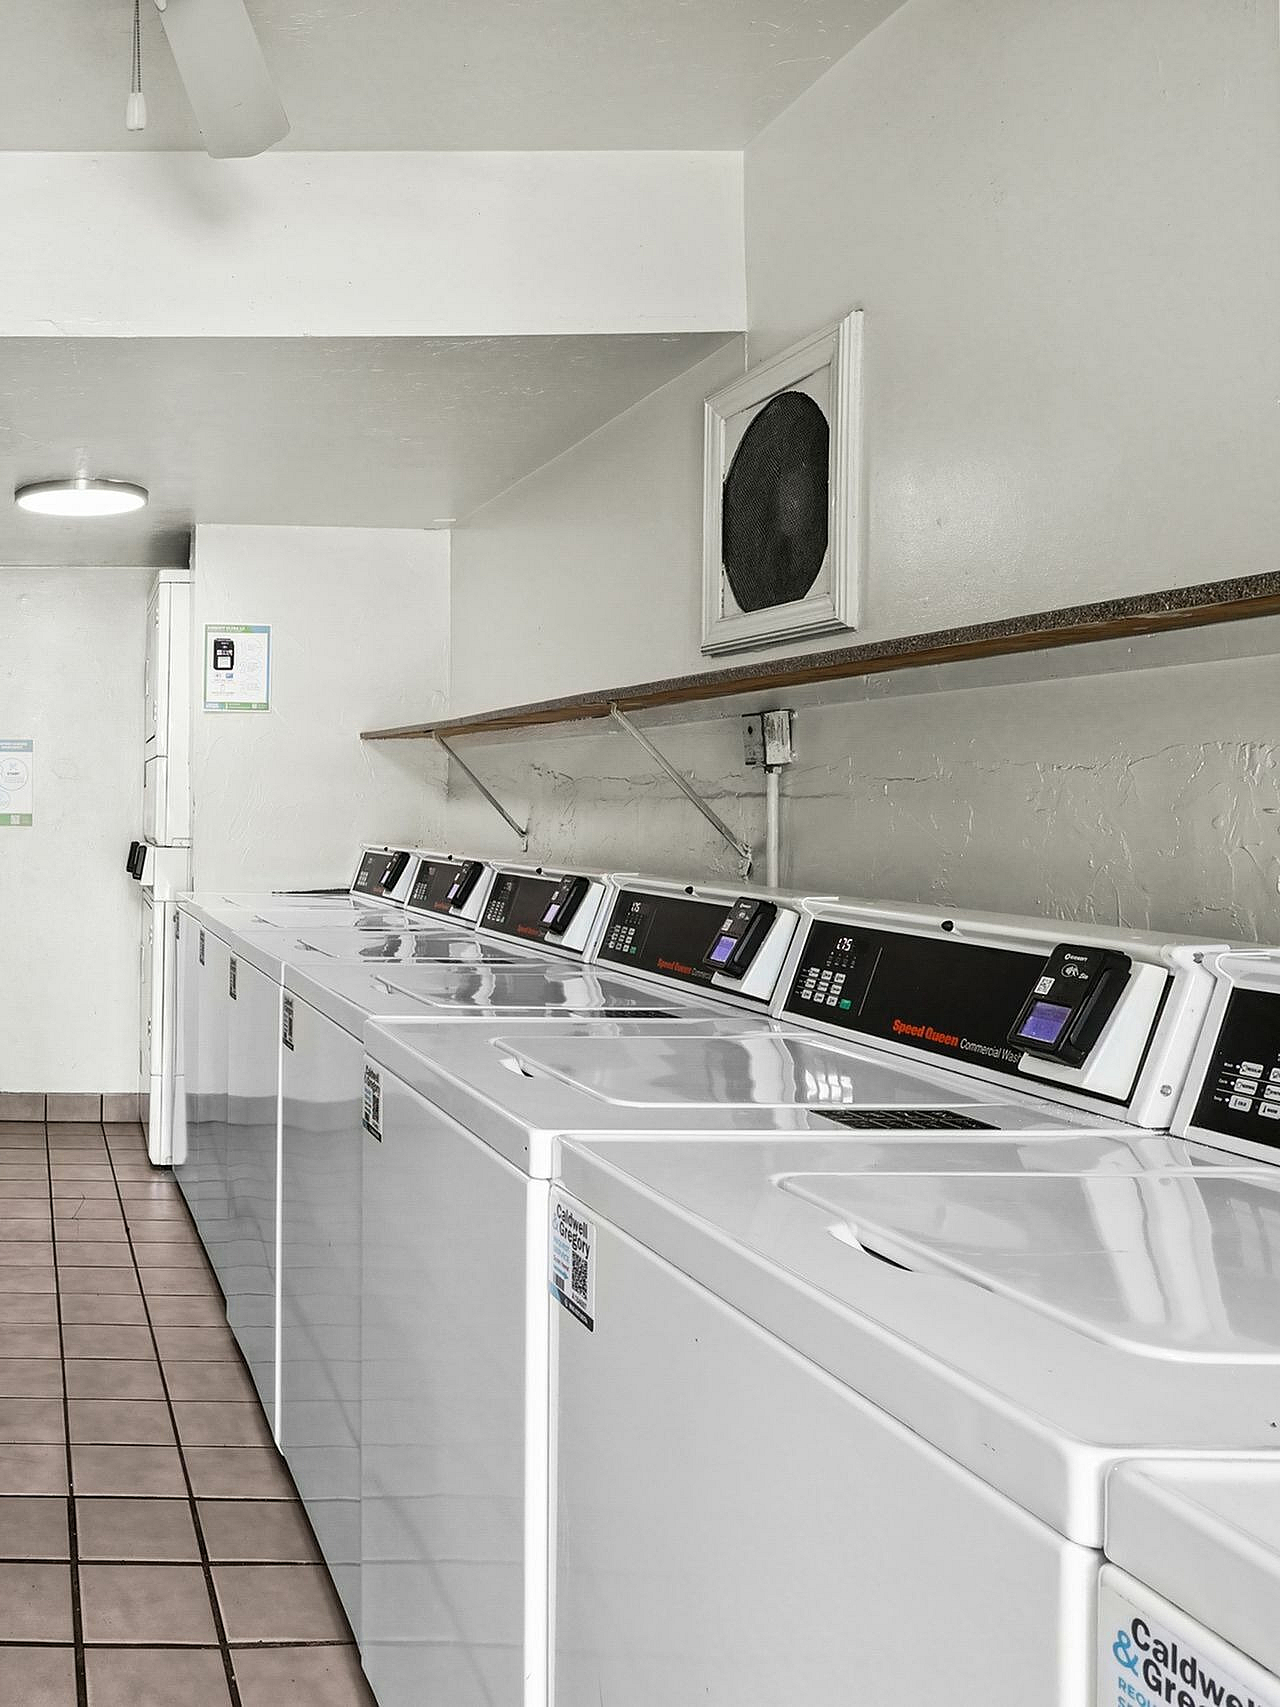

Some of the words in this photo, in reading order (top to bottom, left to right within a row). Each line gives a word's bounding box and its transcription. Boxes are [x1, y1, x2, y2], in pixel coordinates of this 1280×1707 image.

[892, 1020, 925, 1038] Speed
[925, 1026, 959, 1046] Queen
[960, 1038, 1002, 1059] Commercial
[557, 1204, 588, 1239] Caldwell
[560, 1221, 590, 1259] Gregory
[1112, 1630, 1138, 1678] &
